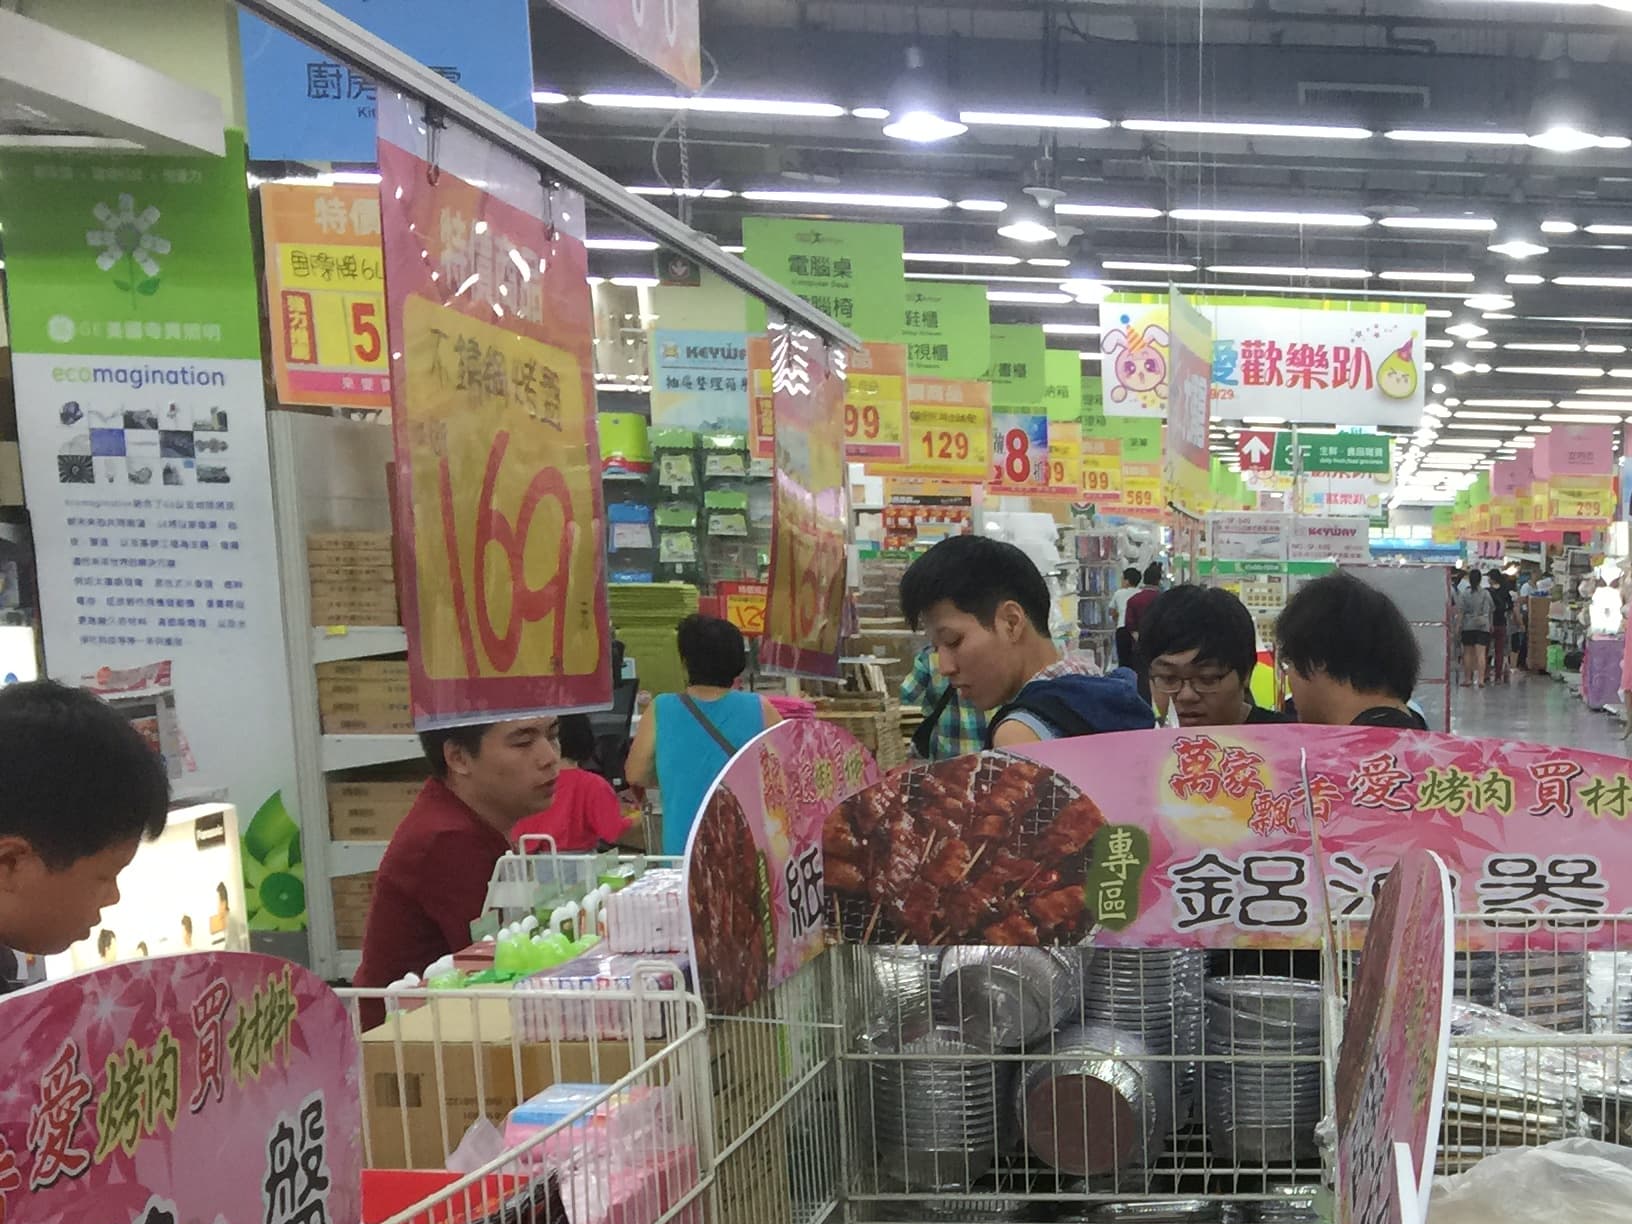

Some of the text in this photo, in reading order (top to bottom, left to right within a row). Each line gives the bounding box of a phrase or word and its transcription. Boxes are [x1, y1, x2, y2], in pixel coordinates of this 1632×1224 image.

[797, 294, 853, 318] 腦椅
[52, 364, 226, 390] ecomagination
[922, 431, 969, 460] 129
[438, 429, 574, 677] 169
[1099, 828, 1141, 922] 專區
